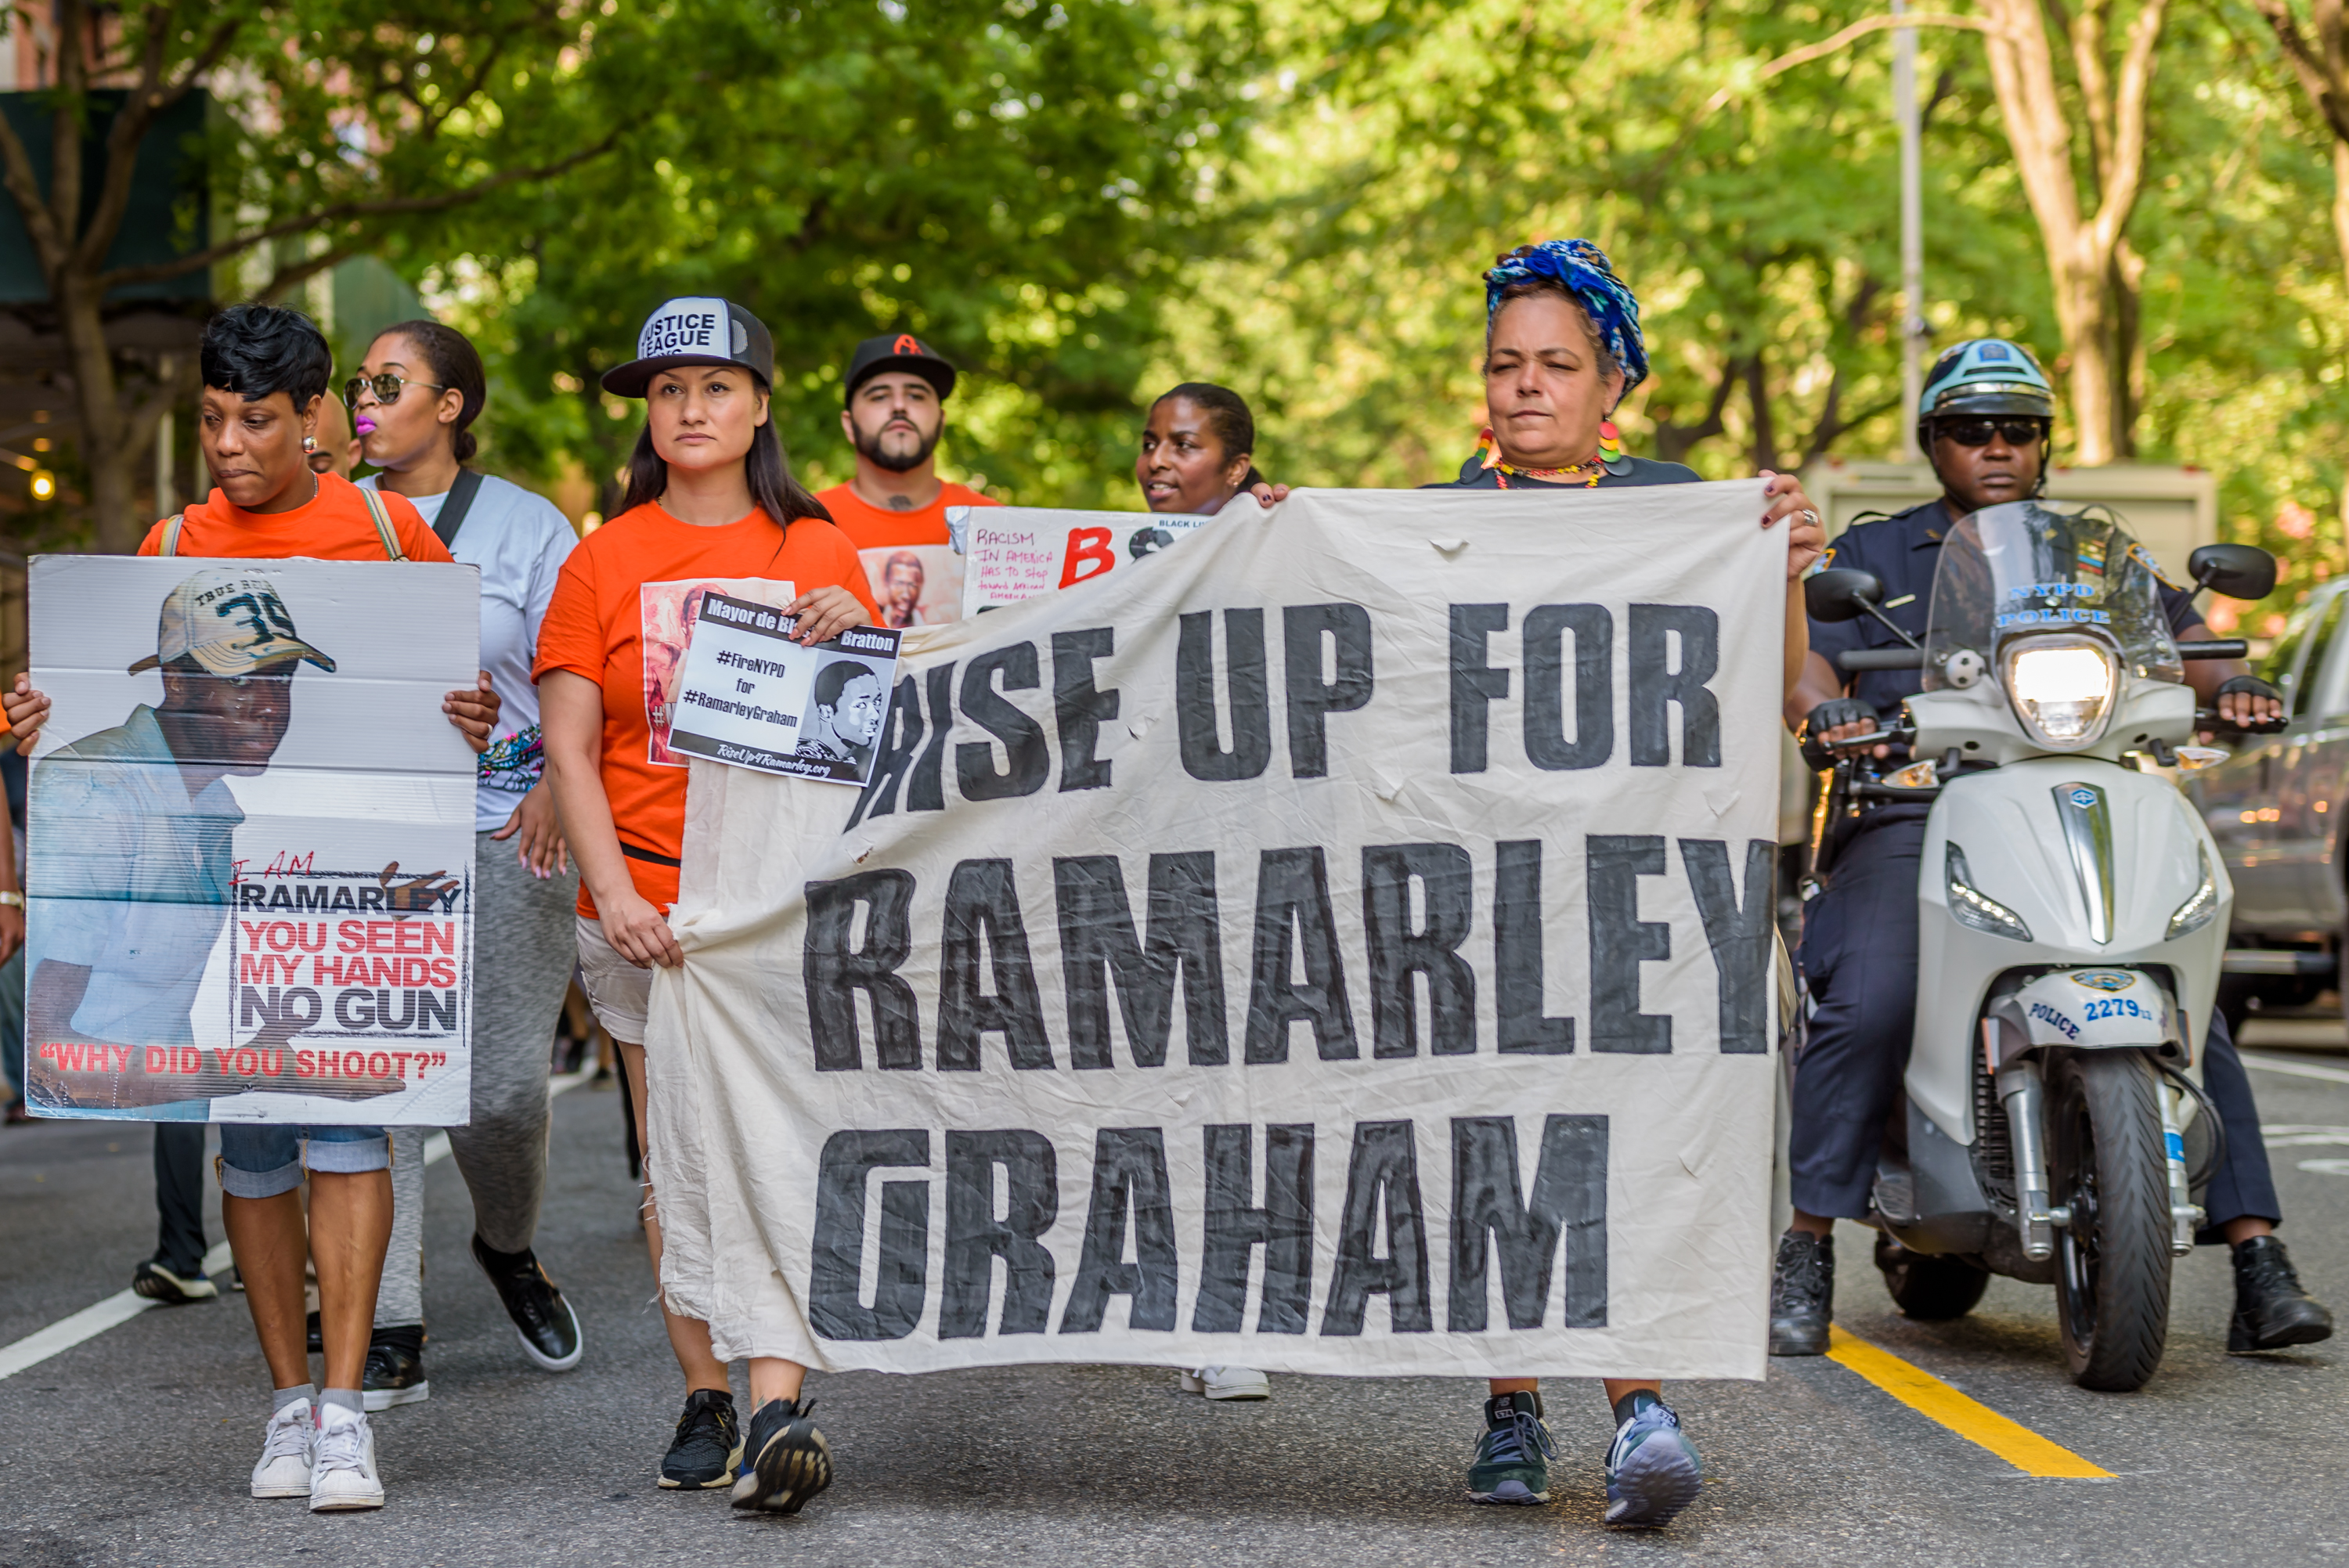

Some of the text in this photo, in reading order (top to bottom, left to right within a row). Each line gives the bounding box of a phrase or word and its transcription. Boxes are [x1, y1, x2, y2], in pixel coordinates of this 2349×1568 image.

[976, 528, 1034, 546] RACISM
[1159, 519, 1190, 528] BLACK
[974, 549, 1052, 564] IN AMERICA
[980, 565, 1001, 578] HAS
[1005, 566, 1019, 577] TO
[2009, 583, 2095, 600] NYPD
[706, 598, 756, 625] Mayor
[755, 612, 777, 630] de
[840, 630, 894, 651] Bratton
[1997, 607, 2112, 628] POLICE
[716, 650, 785, 679] #FireNYPD
[735, 678, 755, 694] for
[1176, 604, 1373, 781] UP
[1451, 604, 1721, 773] FOR
[683, 689, 799, 728] #RamarleyGraham
[716, 744, 831, 778] RiseUp4Ramarley.org
[264, 850, 314, 879] AM
[240, 884, 462, 915] RAMARLEY
[240, 920, 455, 954] YOU SEEN
[803, 834, 1778, 1072] RAMARLEY
[240, 953, 456, 989] MY HANDS
[240, 986, 457, 1031] NO GUN
[2029, 1003, 2080, 1040] POLICE
[2084, 998, 2138, 1022] 2279
[146, 1046, 202, 1074] DID
[214, 1047, 283, 1077] YOU
[809, 1115, 1609, 1340] GRAHAM
